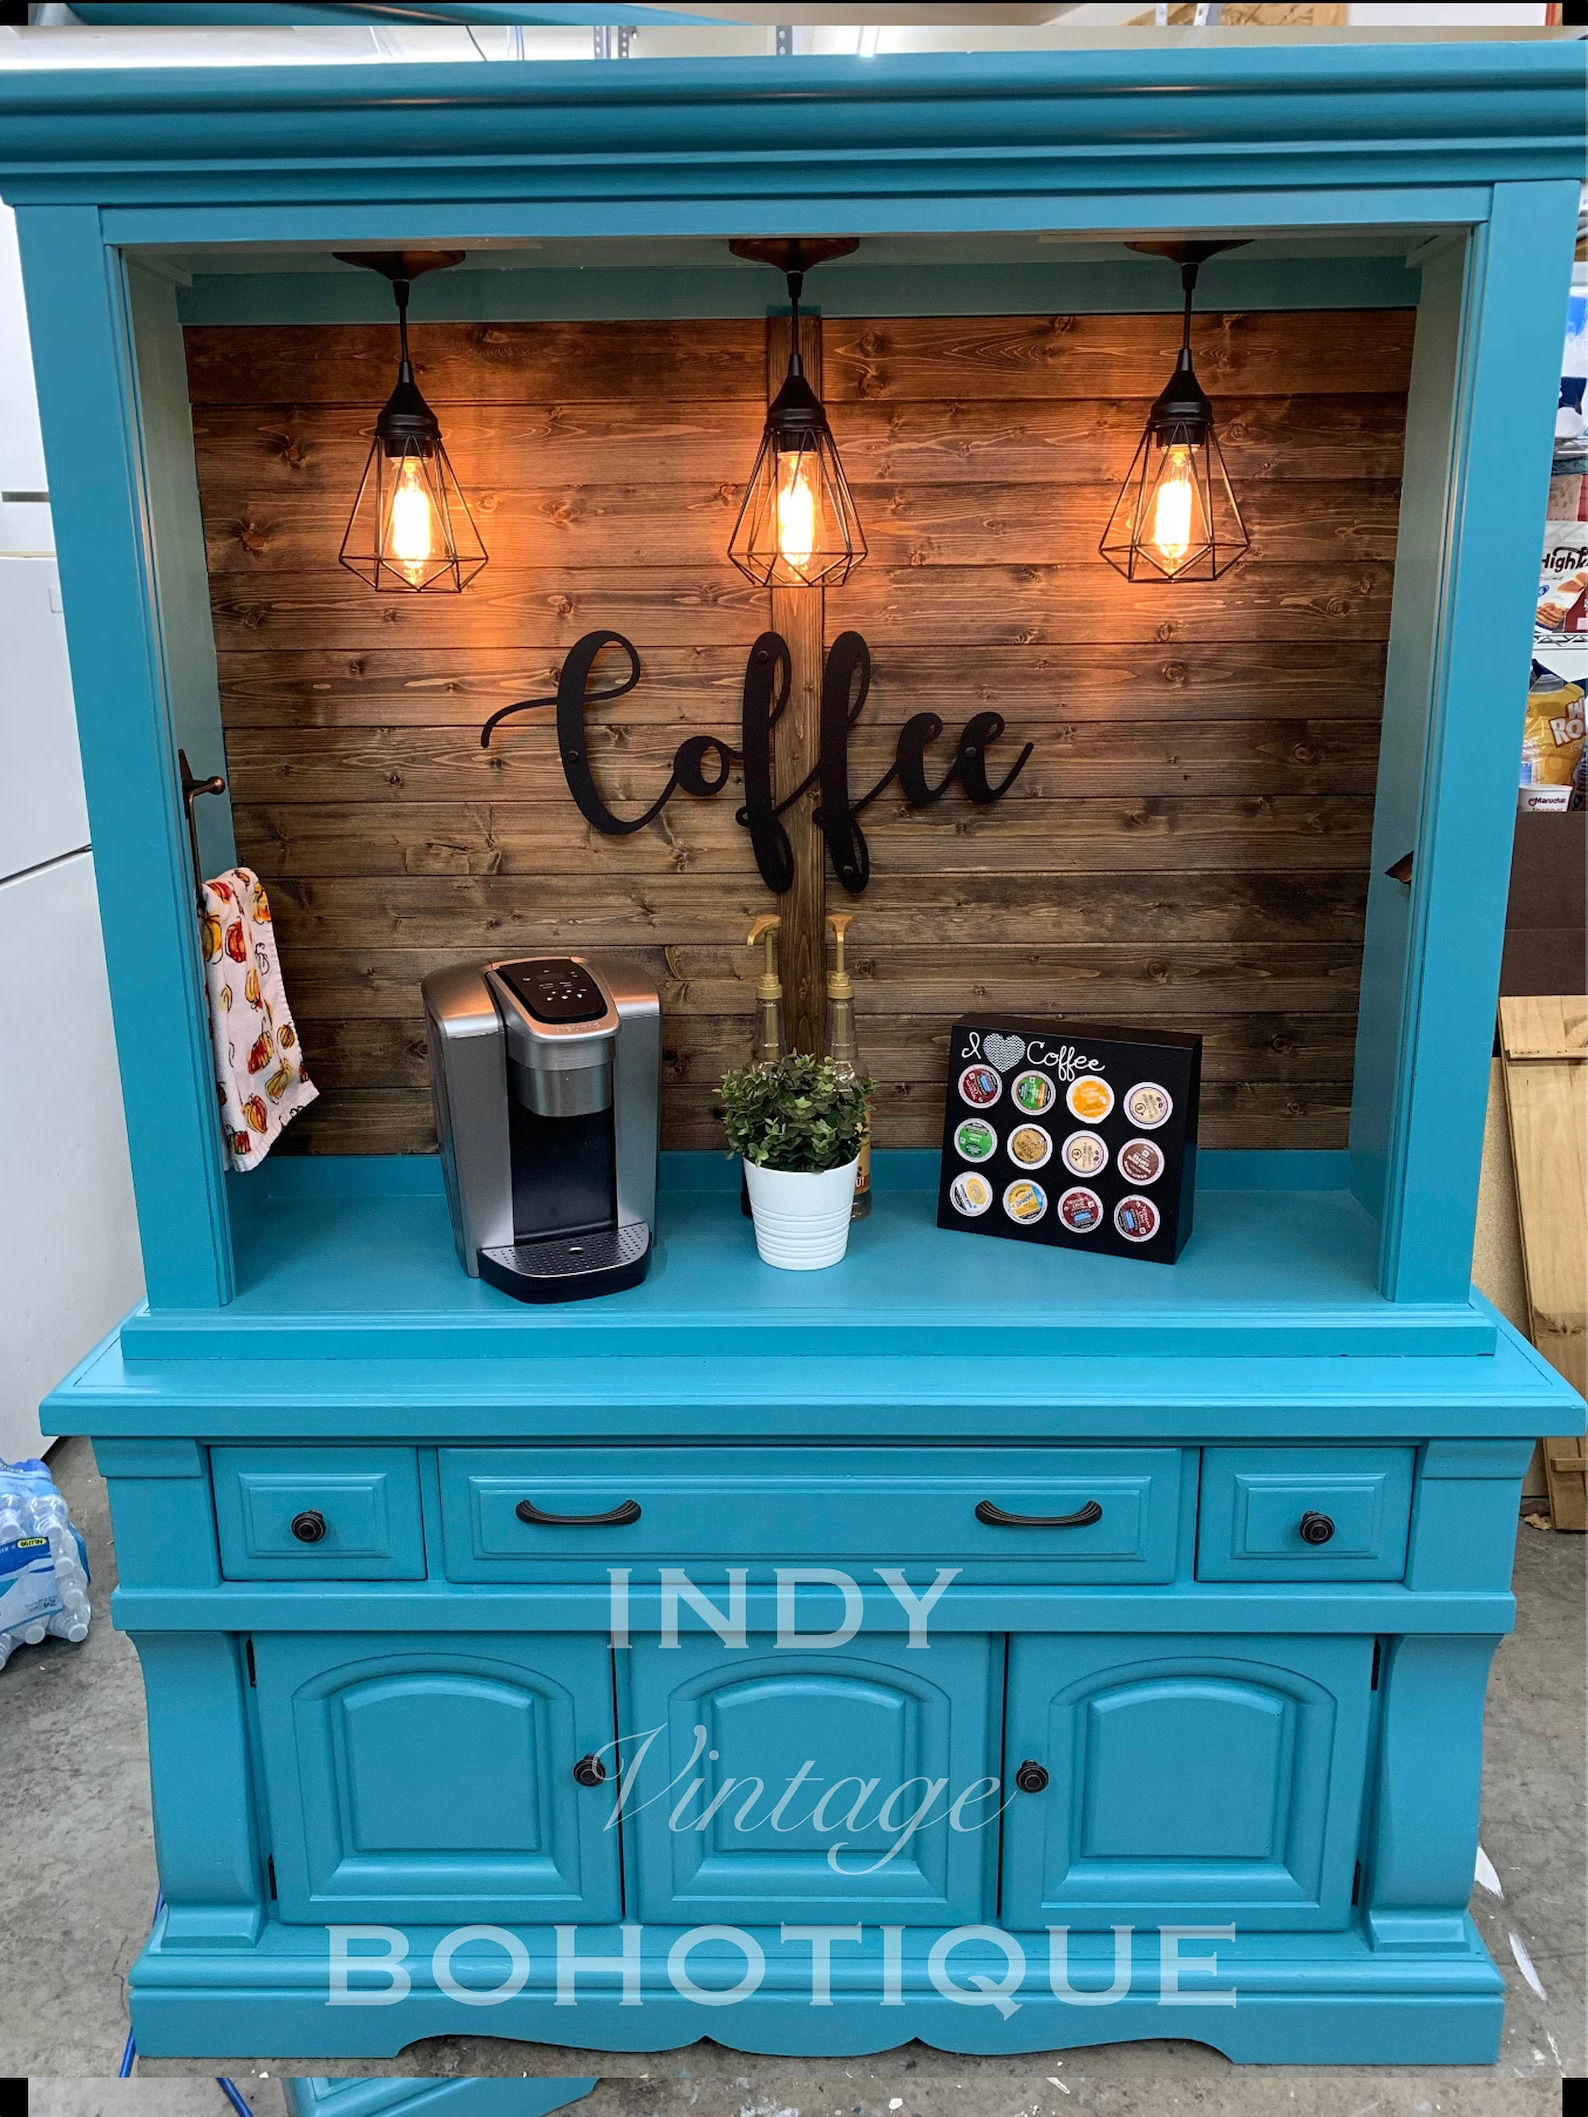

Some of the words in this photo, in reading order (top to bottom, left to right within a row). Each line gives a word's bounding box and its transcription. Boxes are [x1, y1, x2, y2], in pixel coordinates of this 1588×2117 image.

[481, 630, 1034, 894] Coffee
[961, 1031, 981, 1060] I
[1026, 1040, 1106, 1082] Coffee
